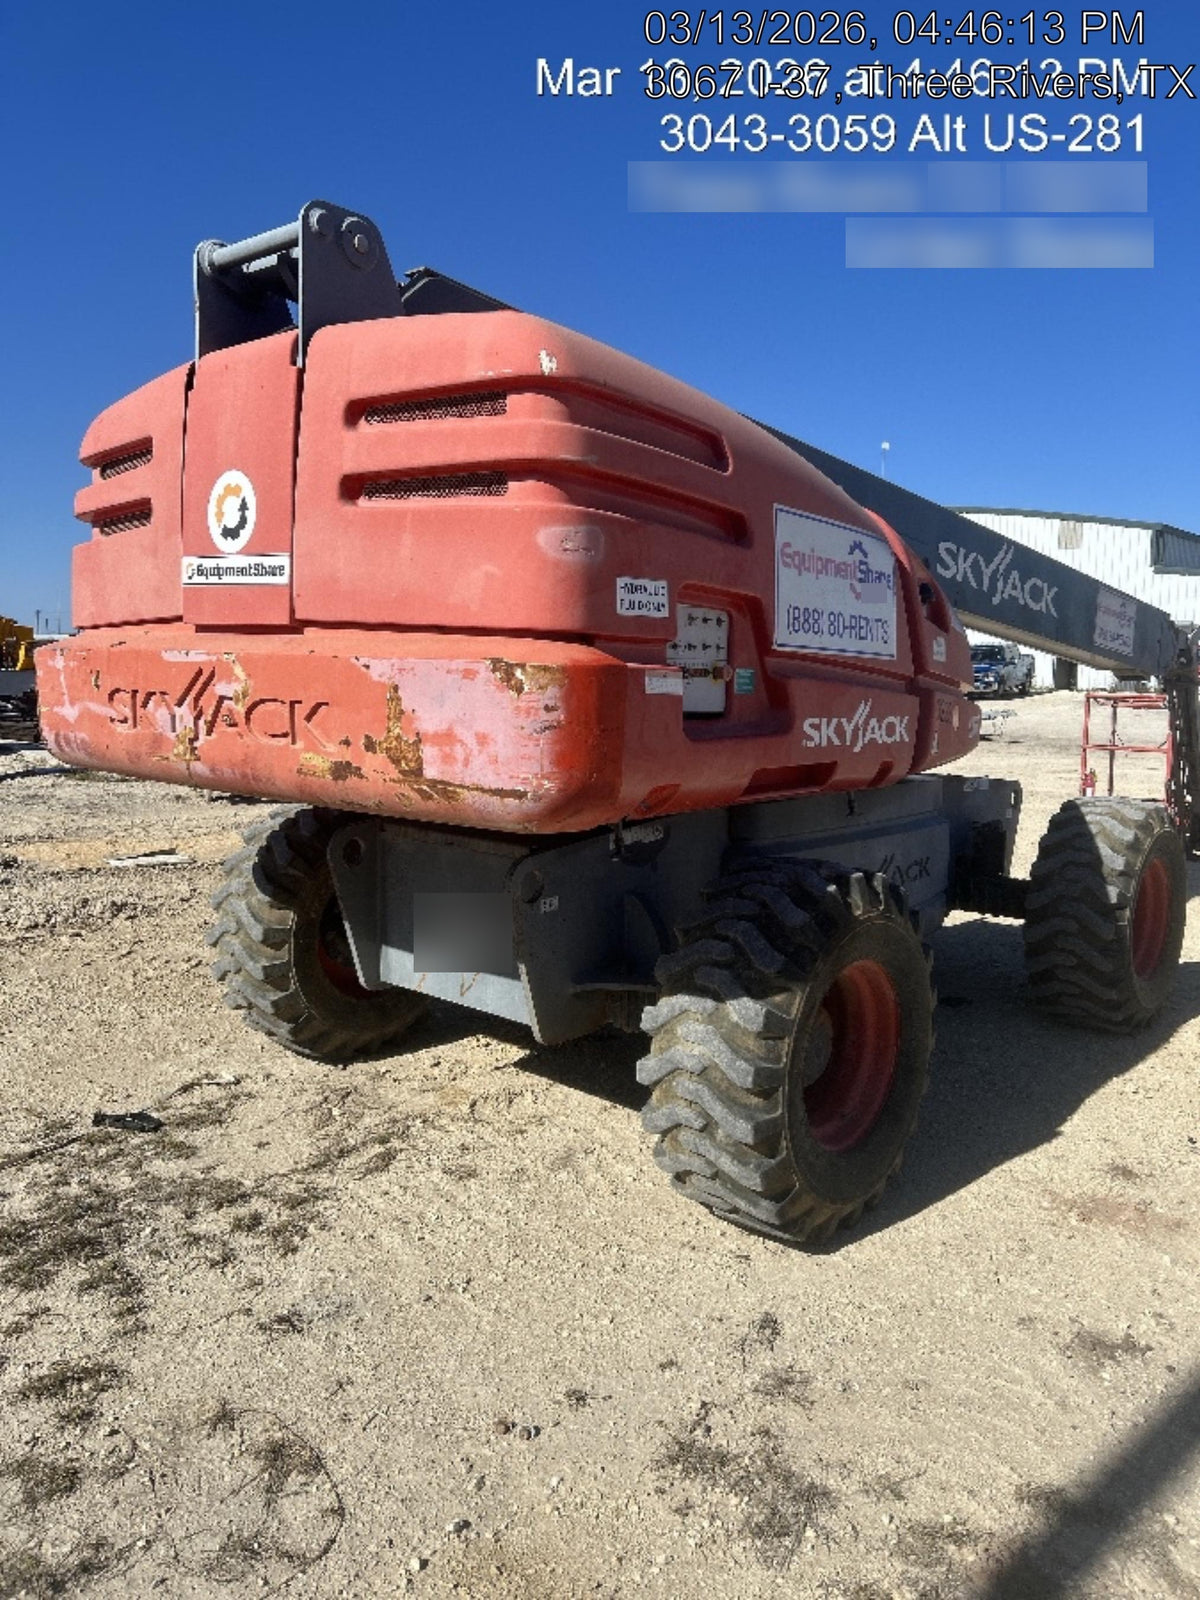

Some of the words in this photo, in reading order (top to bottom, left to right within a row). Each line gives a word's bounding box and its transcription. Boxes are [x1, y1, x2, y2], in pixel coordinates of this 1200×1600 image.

[195, 563, 285, 579] EquipmentShare
[780, 541, 893, 590] EquipmentShare
[936, 541, 1059, 618] SKYJACK
[827, 611, 891, 645] 80-RENTS
[107, 665, 336, 752] SKYJACK
[803, 699, 910, 752] SKYJACK
